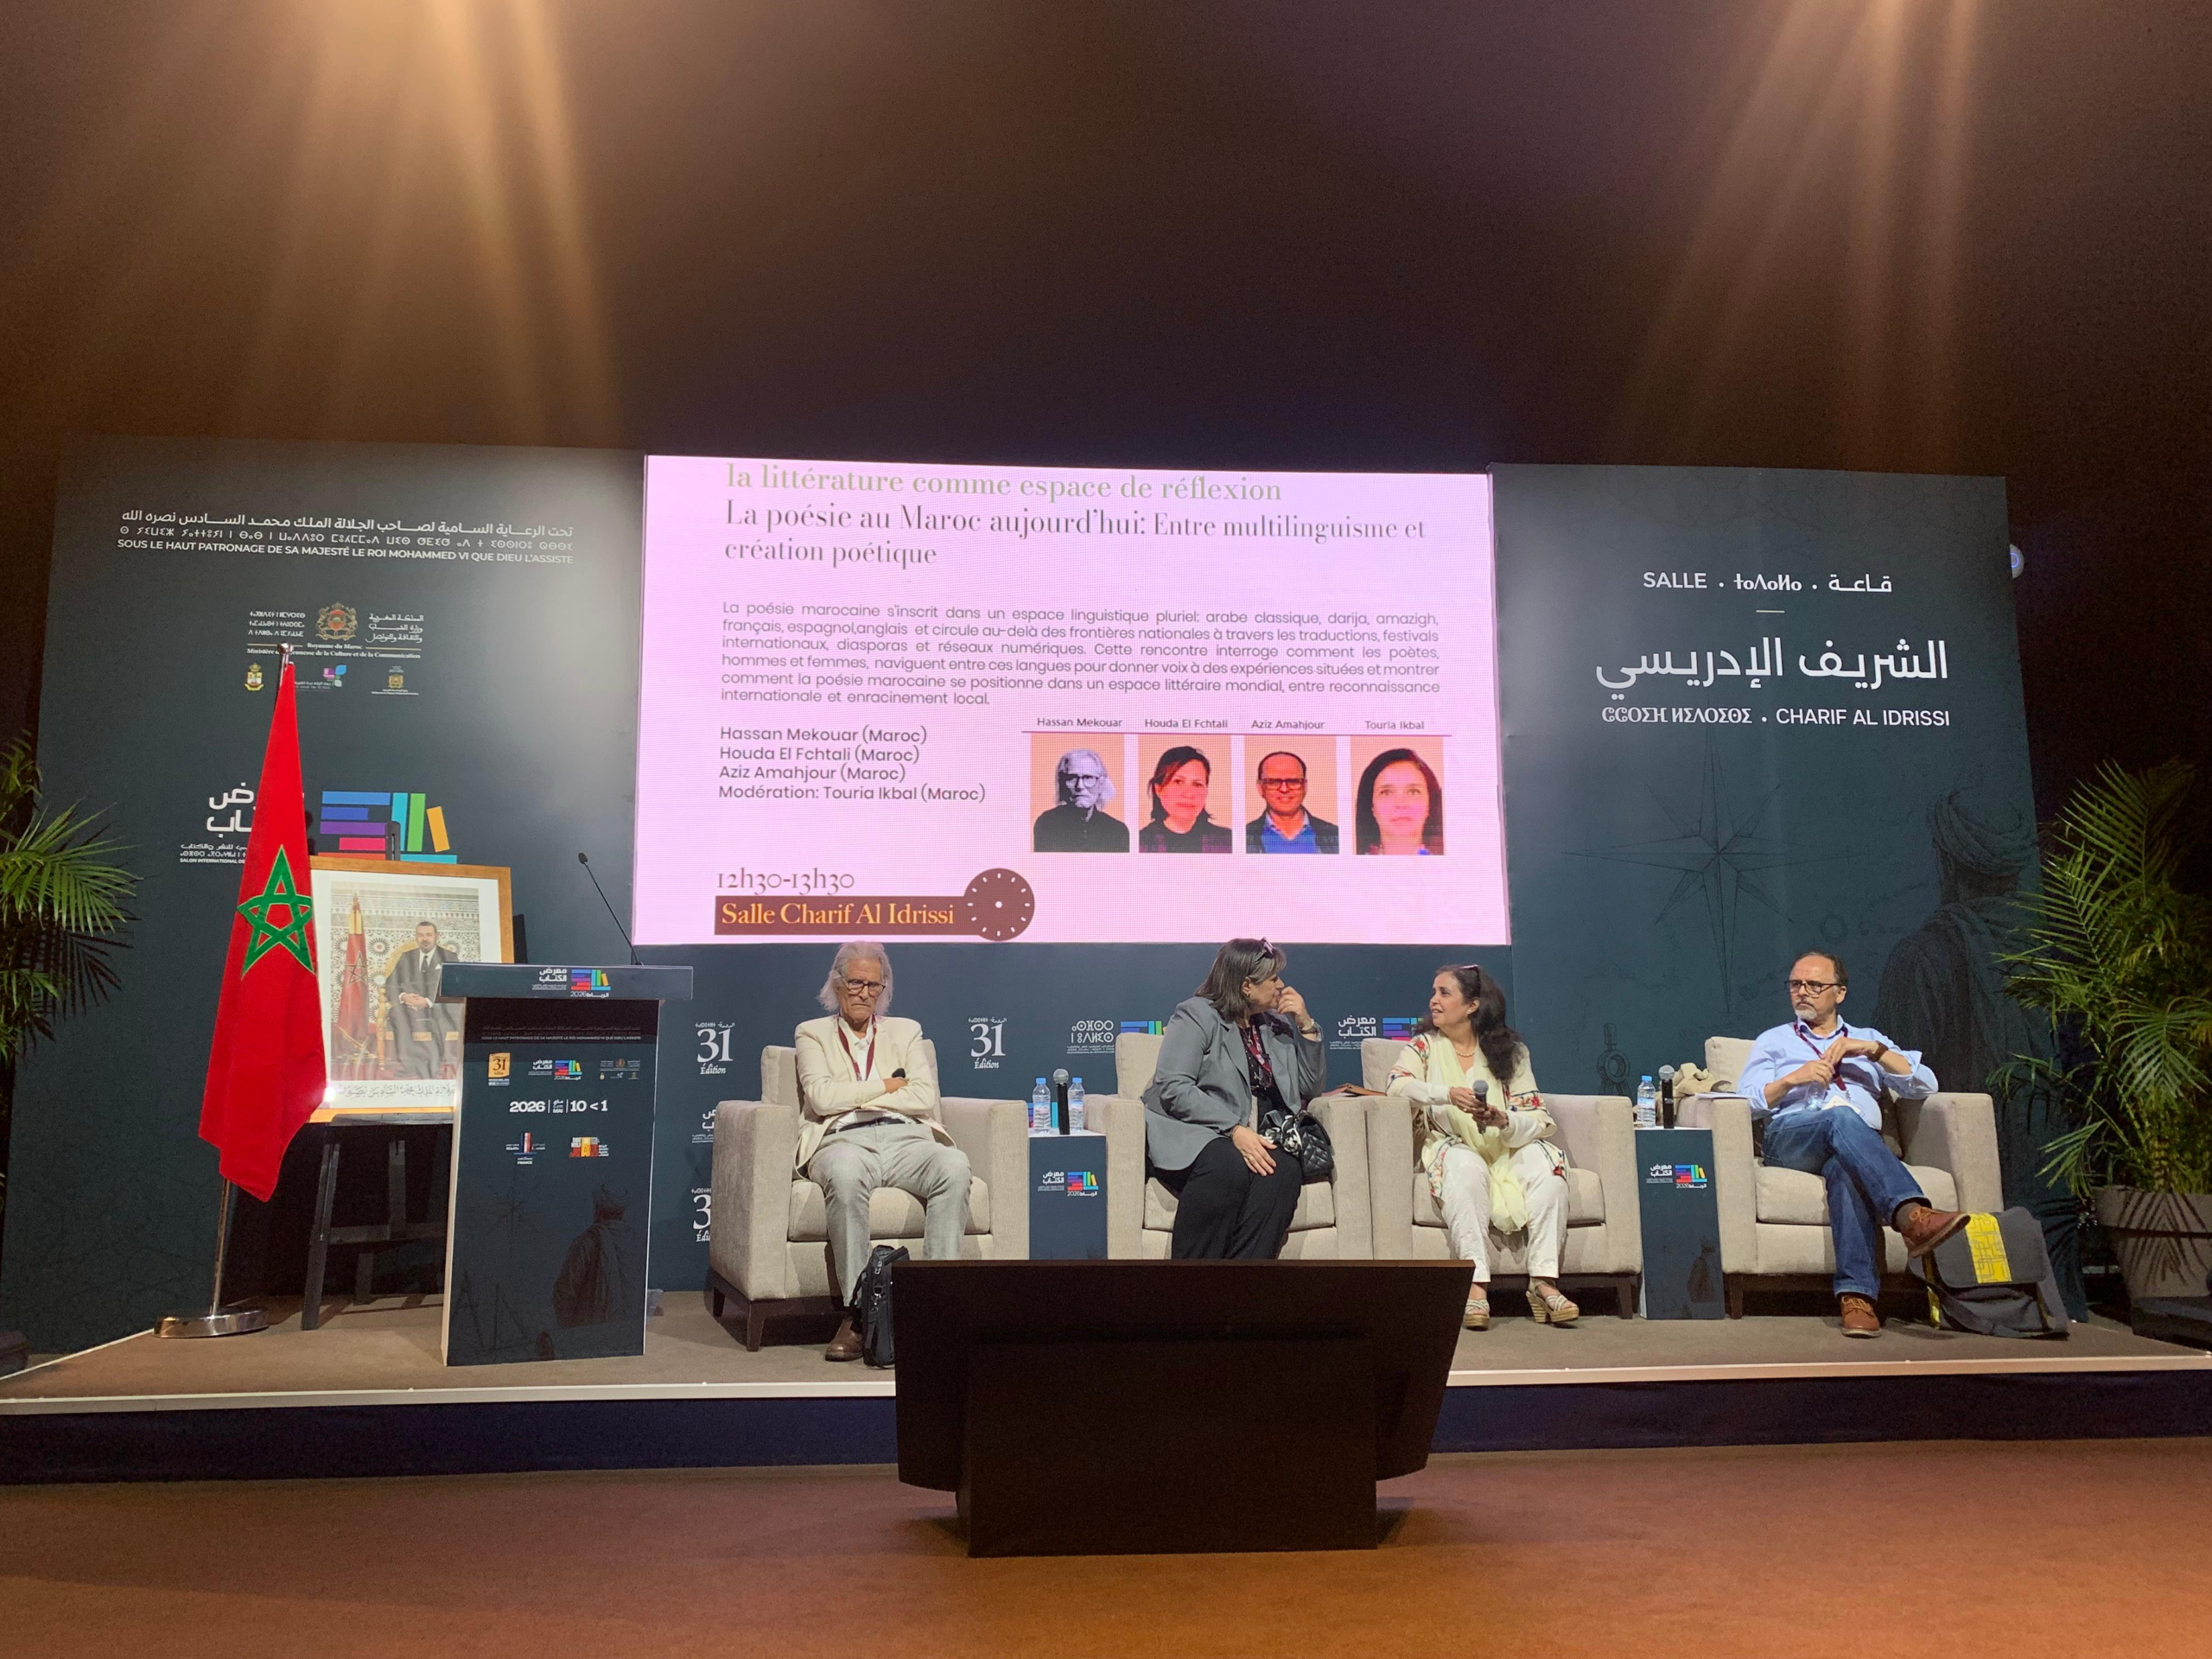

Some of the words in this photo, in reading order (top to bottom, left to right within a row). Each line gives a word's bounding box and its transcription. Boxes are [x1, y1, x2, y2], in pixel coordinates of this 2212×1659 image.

[728, 462, 752, 487] la
[762, 463, 904, 492] littérature
[912, 477, 1011, 495] comme
[1020, 480, 1111, 504] espace
[1120, 474, 1153, 499] de
[1161, 475, 1281, 500] réflexion
[727, 499, 757, 524] La
[767, 502, 852, 533] poésie
[859, 512, 890, 529] au
[901, 504, 981, 531] Maroc
[989, 507, 1145, 540] aujourd'hui:
[1154, 512, 1216, 536] Entre
[1224, 514, 1397, 544] multilinguisme
[1404, 520, 1427, 539] et
[118, 538, 148, 549] SOUS
[149, 540, 163, 550] LE
[165, 541, 196, 550] HAUT
[198, 542, 264, 553] PATRONAGE
[267, 544, 283, 554] DE
[284, 545, 299, 554] SA
[301, 546, 349, 556] MAJESTÉ
[352, 548, 365, 556] LE
[366, 548, 386, 557] ROI
[388, 550, 456, 560] MOHAMMED
[458, 551, 469, 560] VI
[470, 551, 494, 562] QUE
[496, 552, 523, 562] DIEU
[524, 554, 574, 564] L'ASSISTE
[724, 537, 823, 561] création
[832, 539, 937, 570] poétique
[1643, 571, 1707, 588] SALLE
[1828, 573, 1892, 593] قاعة
[722, 601, 740, 613] La
[747, 601, 795, 617] poésie
[801, 604, 880, 617] marocaine
[887, 604, 938, 618] s'inscrit
[945, 606, 981, 619] dans
[987, 609, 1006, 620] un
[1011, 609, 1065, 623] espace
[1071, 608, 1149, 625] linguistique
[1155, 609, 1199, 626] pluriel:
[1205, 610, 1248, 623] arabe
[1254, 611, 1322, 627] classique,
[1327, 612, 1370, 628] darija,
[1376, 612, 1439, 628] amazigh,
[722, 619, 785, 635] français,
[786, 621, 908, 639] espagnol,anglais
[914, 623, 929, 635] et
[931, 623, 979, 637] circule
[982, 625, 1038, 638] au-delà
[1040, 625, 1066, 639] des
[1069, 625, 1135, 639] frontières
[1137, 626, 1211, 640] nationales
[1212, 627, 1223, 640] à
[1225, 628, 1274, 641] travers
[1276, 628, 1296, 641] les
[1298, 628, 1381, 643] traductions,
[1382, 629, 1439, 642] festivals
[721, 635, 830, 652] internationaux,
[836, 638, 908, 654] diasporas
[915, 640, 930, 652] et
[938, 639, 994, 653] réseaux
[1001, 641, 1087, 658] numériques.
[1094, 642, 1133, 656] Cette
[1140, 645, 1208, 657] rencontre
[1215, 644, 1279, 661] interroge
[1286, 646, 1355, 658] comment
[1362, 645, 1382, 658] les
[1389, 645, 1440, 661] poètes,
[1596, 637, 1783, 700] الإدريسي
[1798, 639, 1948, 690] الشريف
[721, 673, 793, 685] comment
[798, 672, 811, 685] la
[816, 673, 863, 689] poésie
[867, 674, 946, 688] marocaine
[950, 677, 967, 688] se
[969, 676, 1044, 691] positionne
[1047, 677, 1084, 690] dans
[1086, 679, 1104, 690] un
[1108, 679, 1161, 694] espace
[1165, 678, 1222, 691] littéraire
[1225, 679, 1285, 693] mondial,
[1287, 681, 1325, 692] entre
[1329, 680, 1440, 693] reconnaissance
[721, 688, 823, 702] internationale
[827, 690, 842, 702] et
[847, 690, 948, 704] enracinement
[953, 691, 990, 705] local.
[1037, 717, 1073, 727] Hassan
[1076, 717, 1122, 728] Mekouar
[1144, 718, 1179, 728] Houda
[1181, 718, 1192, 728] El
[1194, 719, 1228, 728] Fchtali
[1250, 719, 1272, 729] Aziz
[1274, 720, 1325, 730] Amahjour
[1363, 720, 1396, 730] Touria
[1399, 721, 1425, 730] Ikbal
[1776, 708, 1847, 725] CHARIF
[1853, 709, 1878, 725] AL
[1882, 709, 1949, 726] IDRISSI
[720, 727, 784, 741] Hassan
[786, 728, 859, 742] Mekouar
[862, 724, 928, 744] (Maroc)
[720, 747, 775, 760] Houda
[779, 747, 791, 760] El
[796, 747, 851, 762] Fchtali
[854, 745, 920, 765] (Maroc)
[719, 764, 750, 779] Aziz
[753, 765, 836, 783] Amahjour
[840, 763, 906, 783] (Maroc)
[719, 785, 819, 799] Modération:
[823, 785, 874, 799] Touria
[878, 786, 918, 800] Ikbal
[920, 784, 986, 804] (Maroc)
[717, 868, 855, 895] 12h30-13h30
[721, 903, 776, 925] Salle
[779, 903, 854, 925] Charif
[855, 903, 881, 925] Al
[888, 903, 955, 925] Idrissi
[1338, 1014, 1376, 1027] معرض
[970, 1023, 1007, 1058] 31
[1338, 1027, 1376, 1039] الكتاب
[696, 1028, 734, 1063] 31
[493, 1058, 506, 1071] 31
[700, 1063, 726, 1075] Édition
[974, 1057, 1000, 1069] Édition
[509, 1101, 546, 1113] 2026
[570, 1100, 588, 1112] 10
[601, 1099, 608, 1112] 1
[693, 1194, 711, 1230] 3
